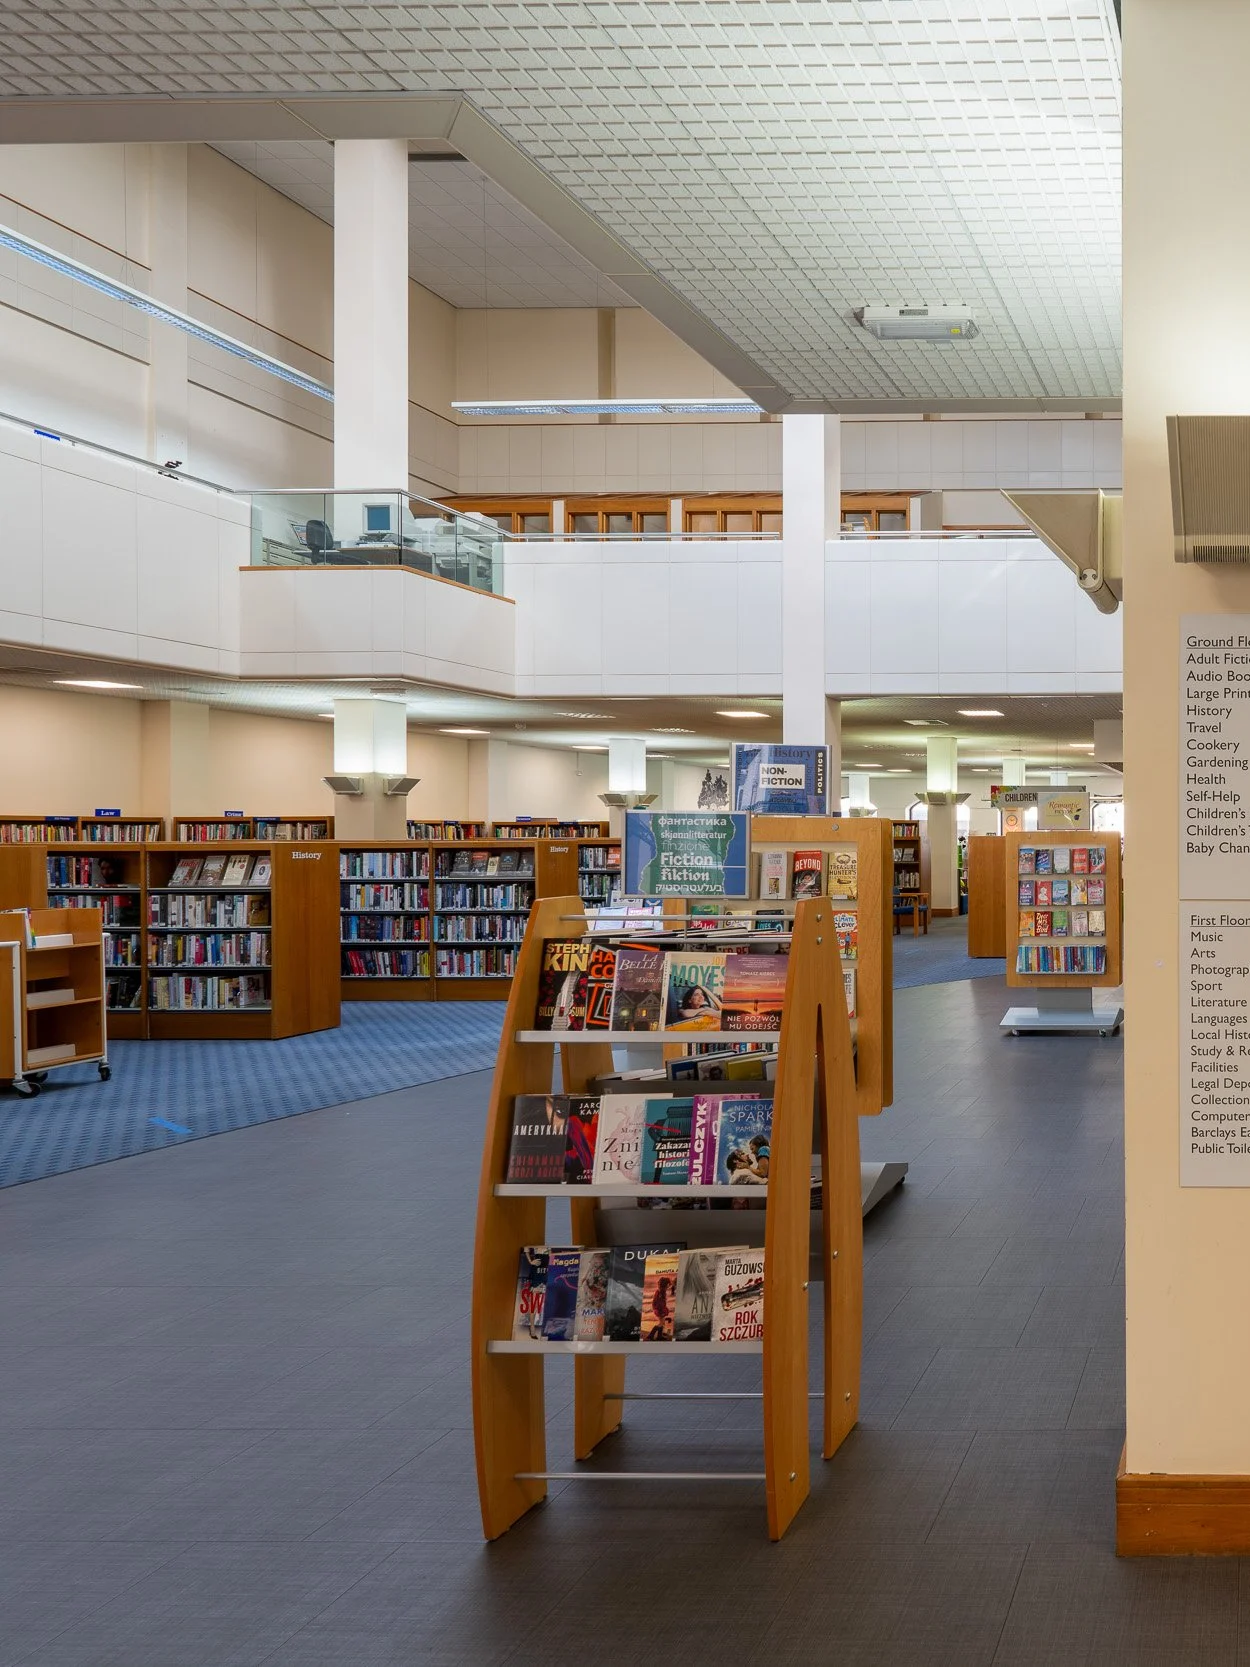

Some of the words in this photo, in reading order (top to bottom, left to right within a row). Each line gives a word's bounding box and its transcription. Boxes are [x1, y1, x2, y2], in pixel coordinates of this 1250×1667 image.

[1187, 634, 1233, 648] Ground
[1187, 652, 1220, 664] Adult
[1187, 669, 1222, 681] Audio
[1187, 687, 1219, 702] Large
[1187, 704, 1232, 719] History
[1187, 721, 1221, 733] Travel
[1187, 738, 1240, 753] Cookery
[1187, 755, 1248, 771] Gardening
[762, 766, 787, 775] NON-
[762, 777, 802, 786] FICTION
[1187, 772, 1225, 784] Health
[1004, 793, 1038, 802] CHILDREN
[1187, 789, 1240, 805] Self-Help
[1187, 807, 1245, 820] Children's
[658, 815, 727, 828] фантастика
[1187, 824, 1245, 836] Children's
[549, 846, 569, 854] History
[1187, 841, 1214, 856] Baby
[291, 851, 322, 860] History
[660, 851, 714, 866] Fiction
[795, 858, 821, 871] BEYOND
[660, 867, 710, 881] fiktion
[1191, 914, 1216, 925] First
[1221, 914, 1250, 925] Floor
[1191, 930, 1223, 942] Music
[592, 950, 614, 963] HA
[1191, 947, 1215, 958] Arts
[543, 953, 589, 972] KIN
[618, 958, 657, 971] BELLE
[590, 963, 615, 979] CO
[1191, 979, 1223, 994] Sport
[1191, 995, 1247, 1007] Literature
[727, 1015, 744, 1023] NIE
[1191, 1012, 1247, 1026] Languages
[729, 1023, 742, 1031] MU
[1191, 1028, 1220, 1039] Local
[1191, 1044, 1222, 1059] Study
[1226, 1045, 1234, 1056] &
[1191, 1061, 1238, 1072] Facilities
[1192, 1077, 1219, 1091] Legal
[1191, 1093, 1249, 1105] Collection
[1191, 1110, 1250, 1124] Computer
[1192, 1126, 1236, 1140] Barclays
[1192, 1142, 1224, 1153] Public
[553, 1257, 579, 1267] Magda
[724, 1263, 764, 1277] GUZOWS
[734, 1310, 759, 1326] ROK
[719, 1324, 764, 1342] SZCZUR
